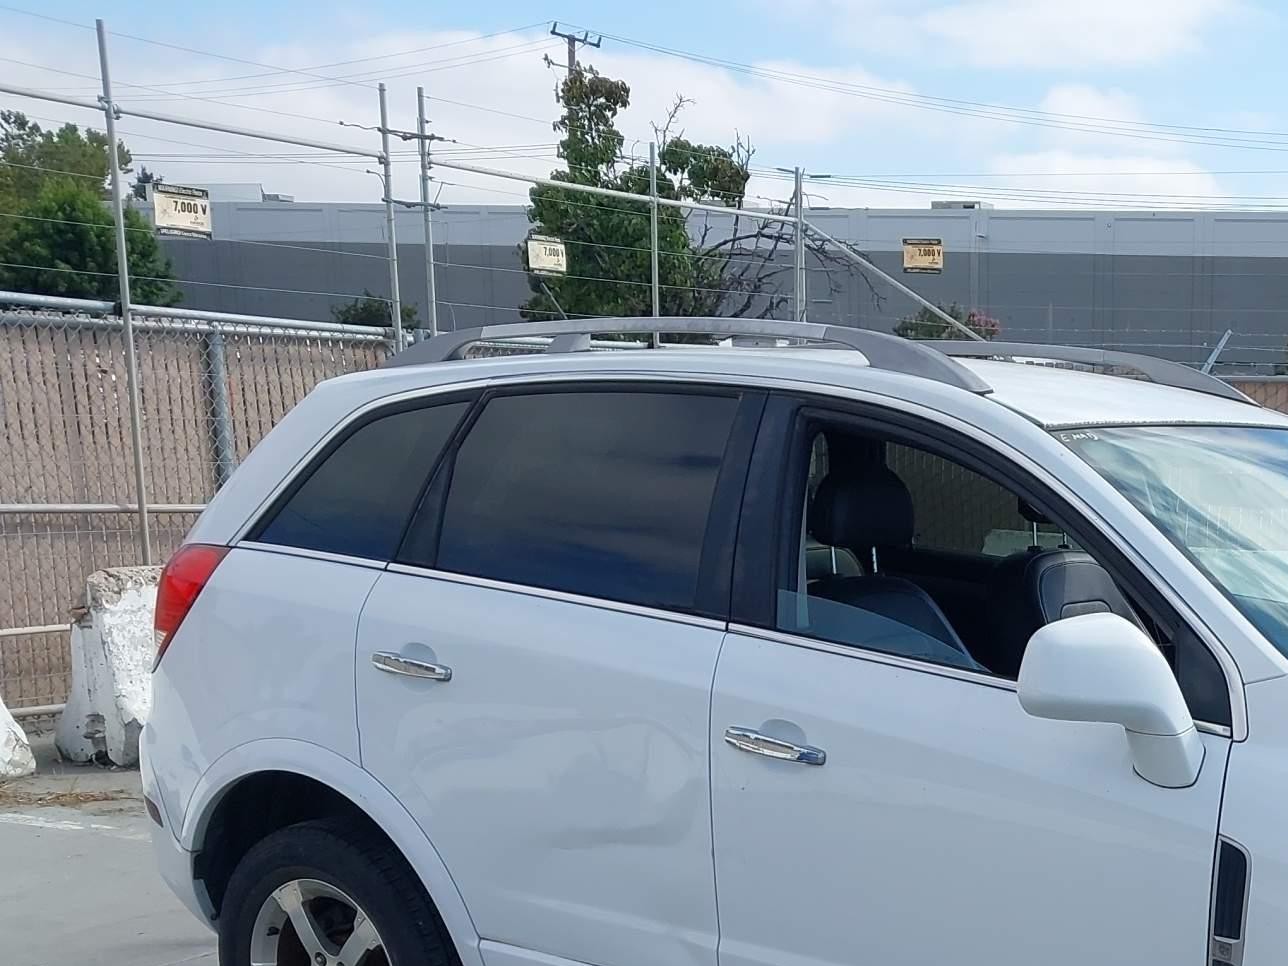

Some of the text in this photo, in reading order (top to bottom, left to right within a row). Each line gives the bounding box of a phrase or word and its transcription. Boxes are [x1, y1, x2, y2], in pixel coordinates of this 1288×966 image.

[173, 200, 207, 216] 7,000 V
[543, 246, 560, 258] 7,000
[918, 248, 941, 257] 7,000 V
